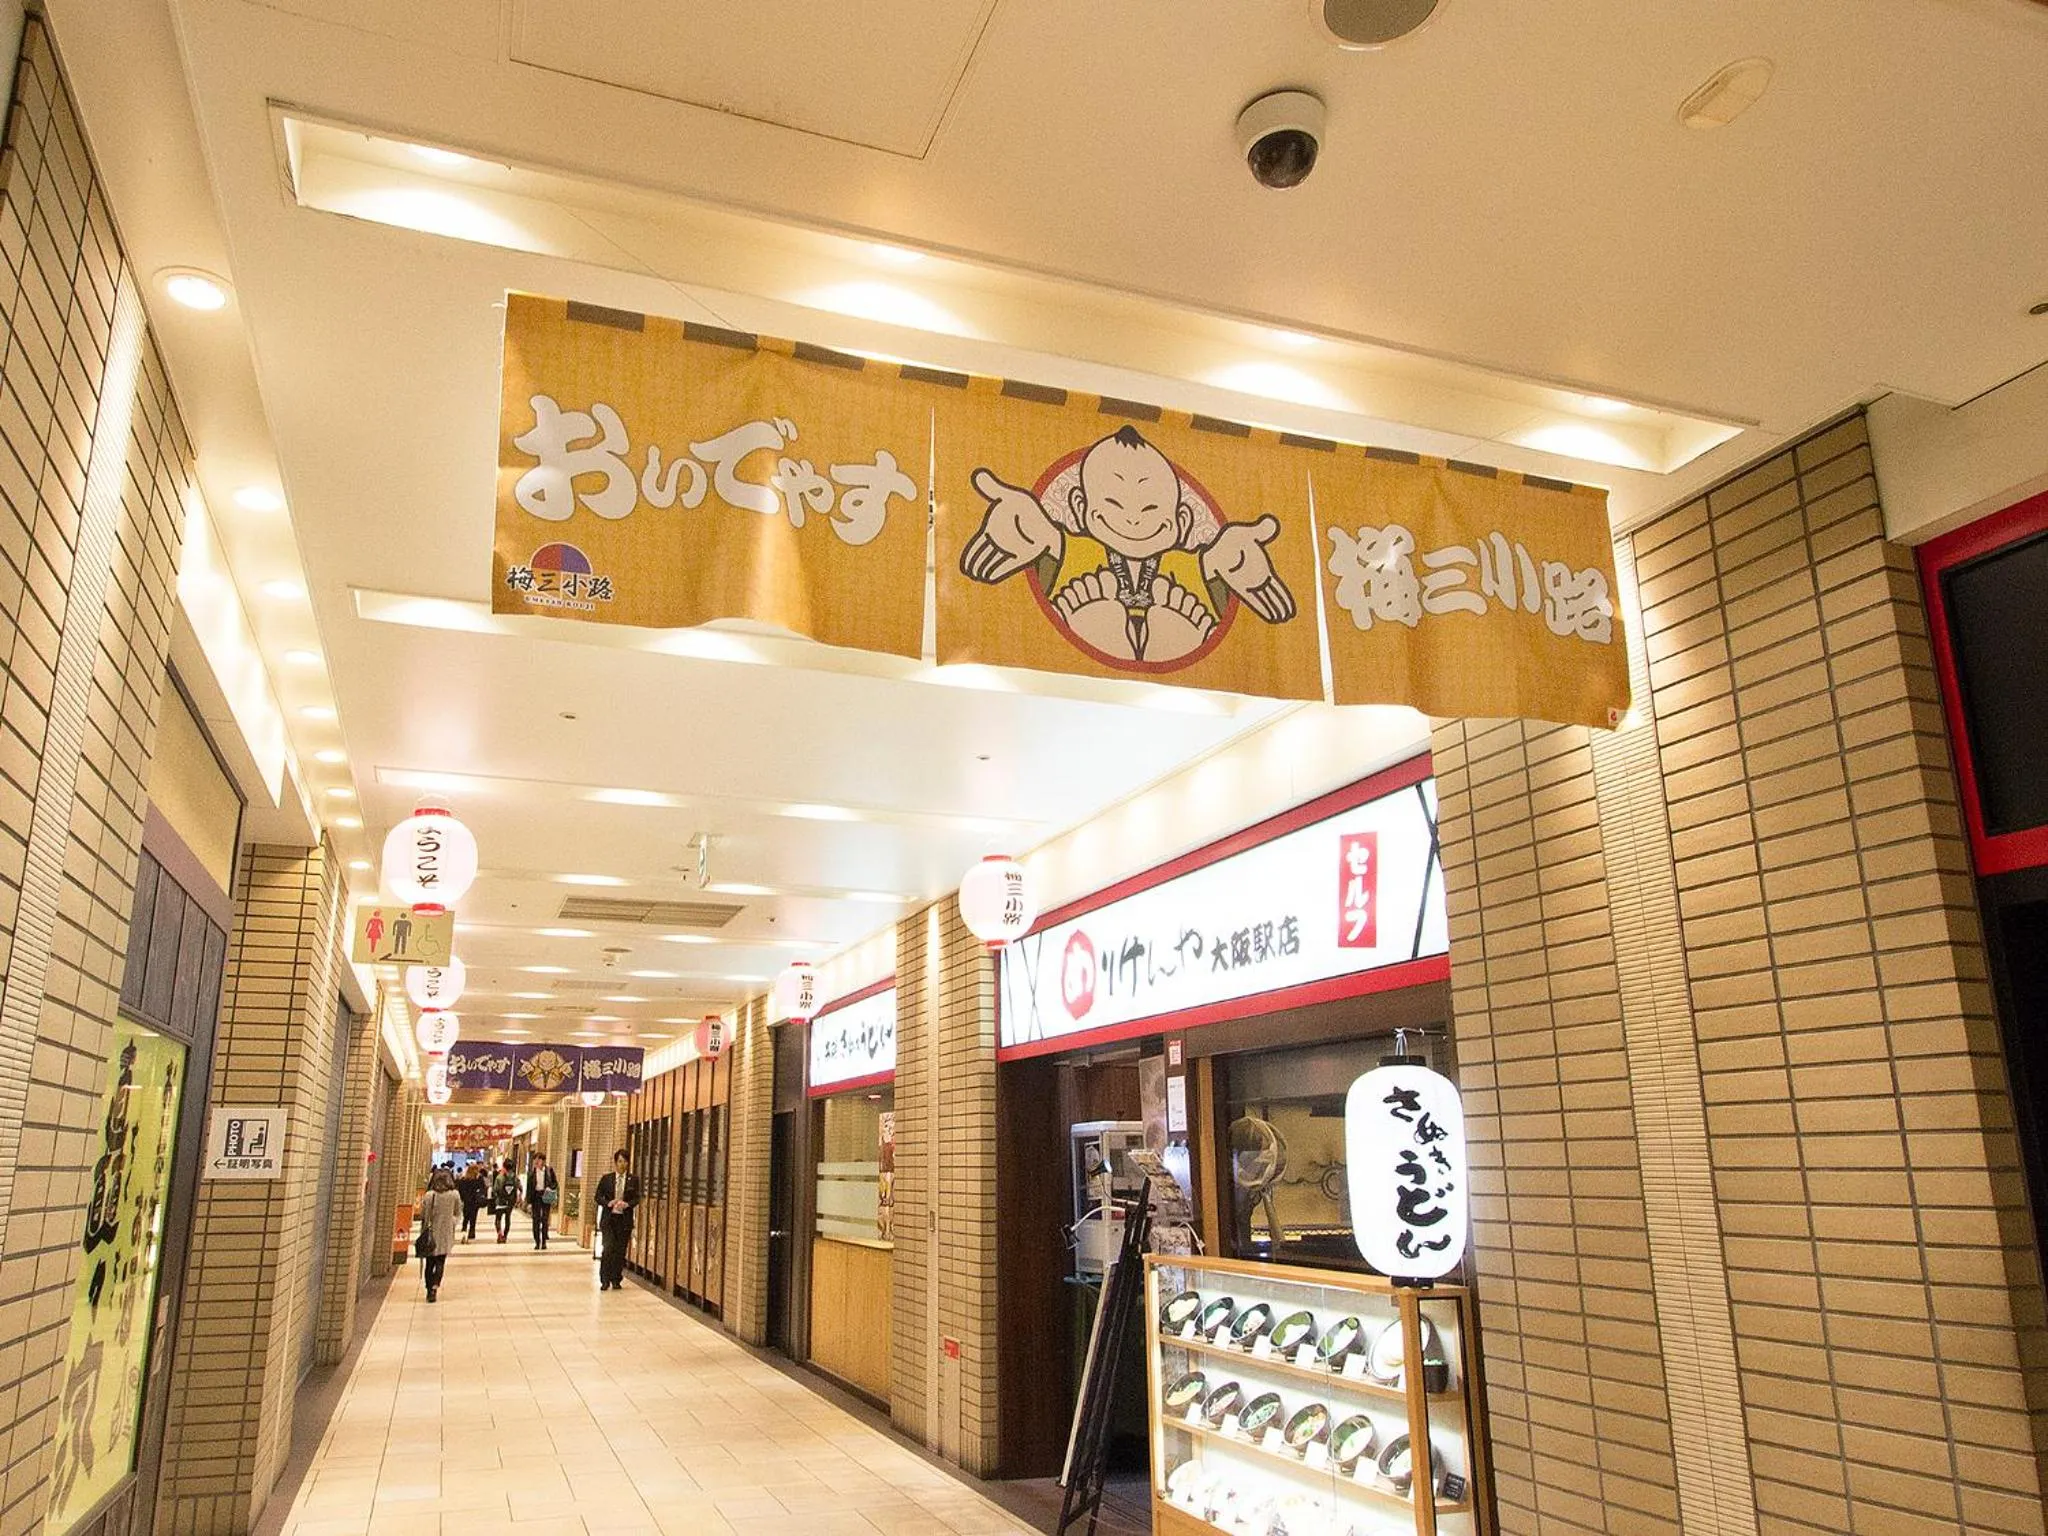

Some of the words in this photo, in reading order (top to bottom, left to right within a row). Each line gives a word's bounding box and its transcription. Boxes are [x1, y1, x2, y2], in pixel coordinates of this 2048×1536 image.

[513, 394, 919, 546] おいでやす
[506, 566, 615, 601] 梅三小路
[1326, 523, 1615, 645] 梅三小路
[415, 826, 442, 890] ようこそ
[1343, 840, 1371, 943] セルフ
[227, 1120, 241, 1156] PHOTO
[227, 1158, 273, 1170] 証明写真
[1382, 1085, 1455, 1260] さぬきうどん
